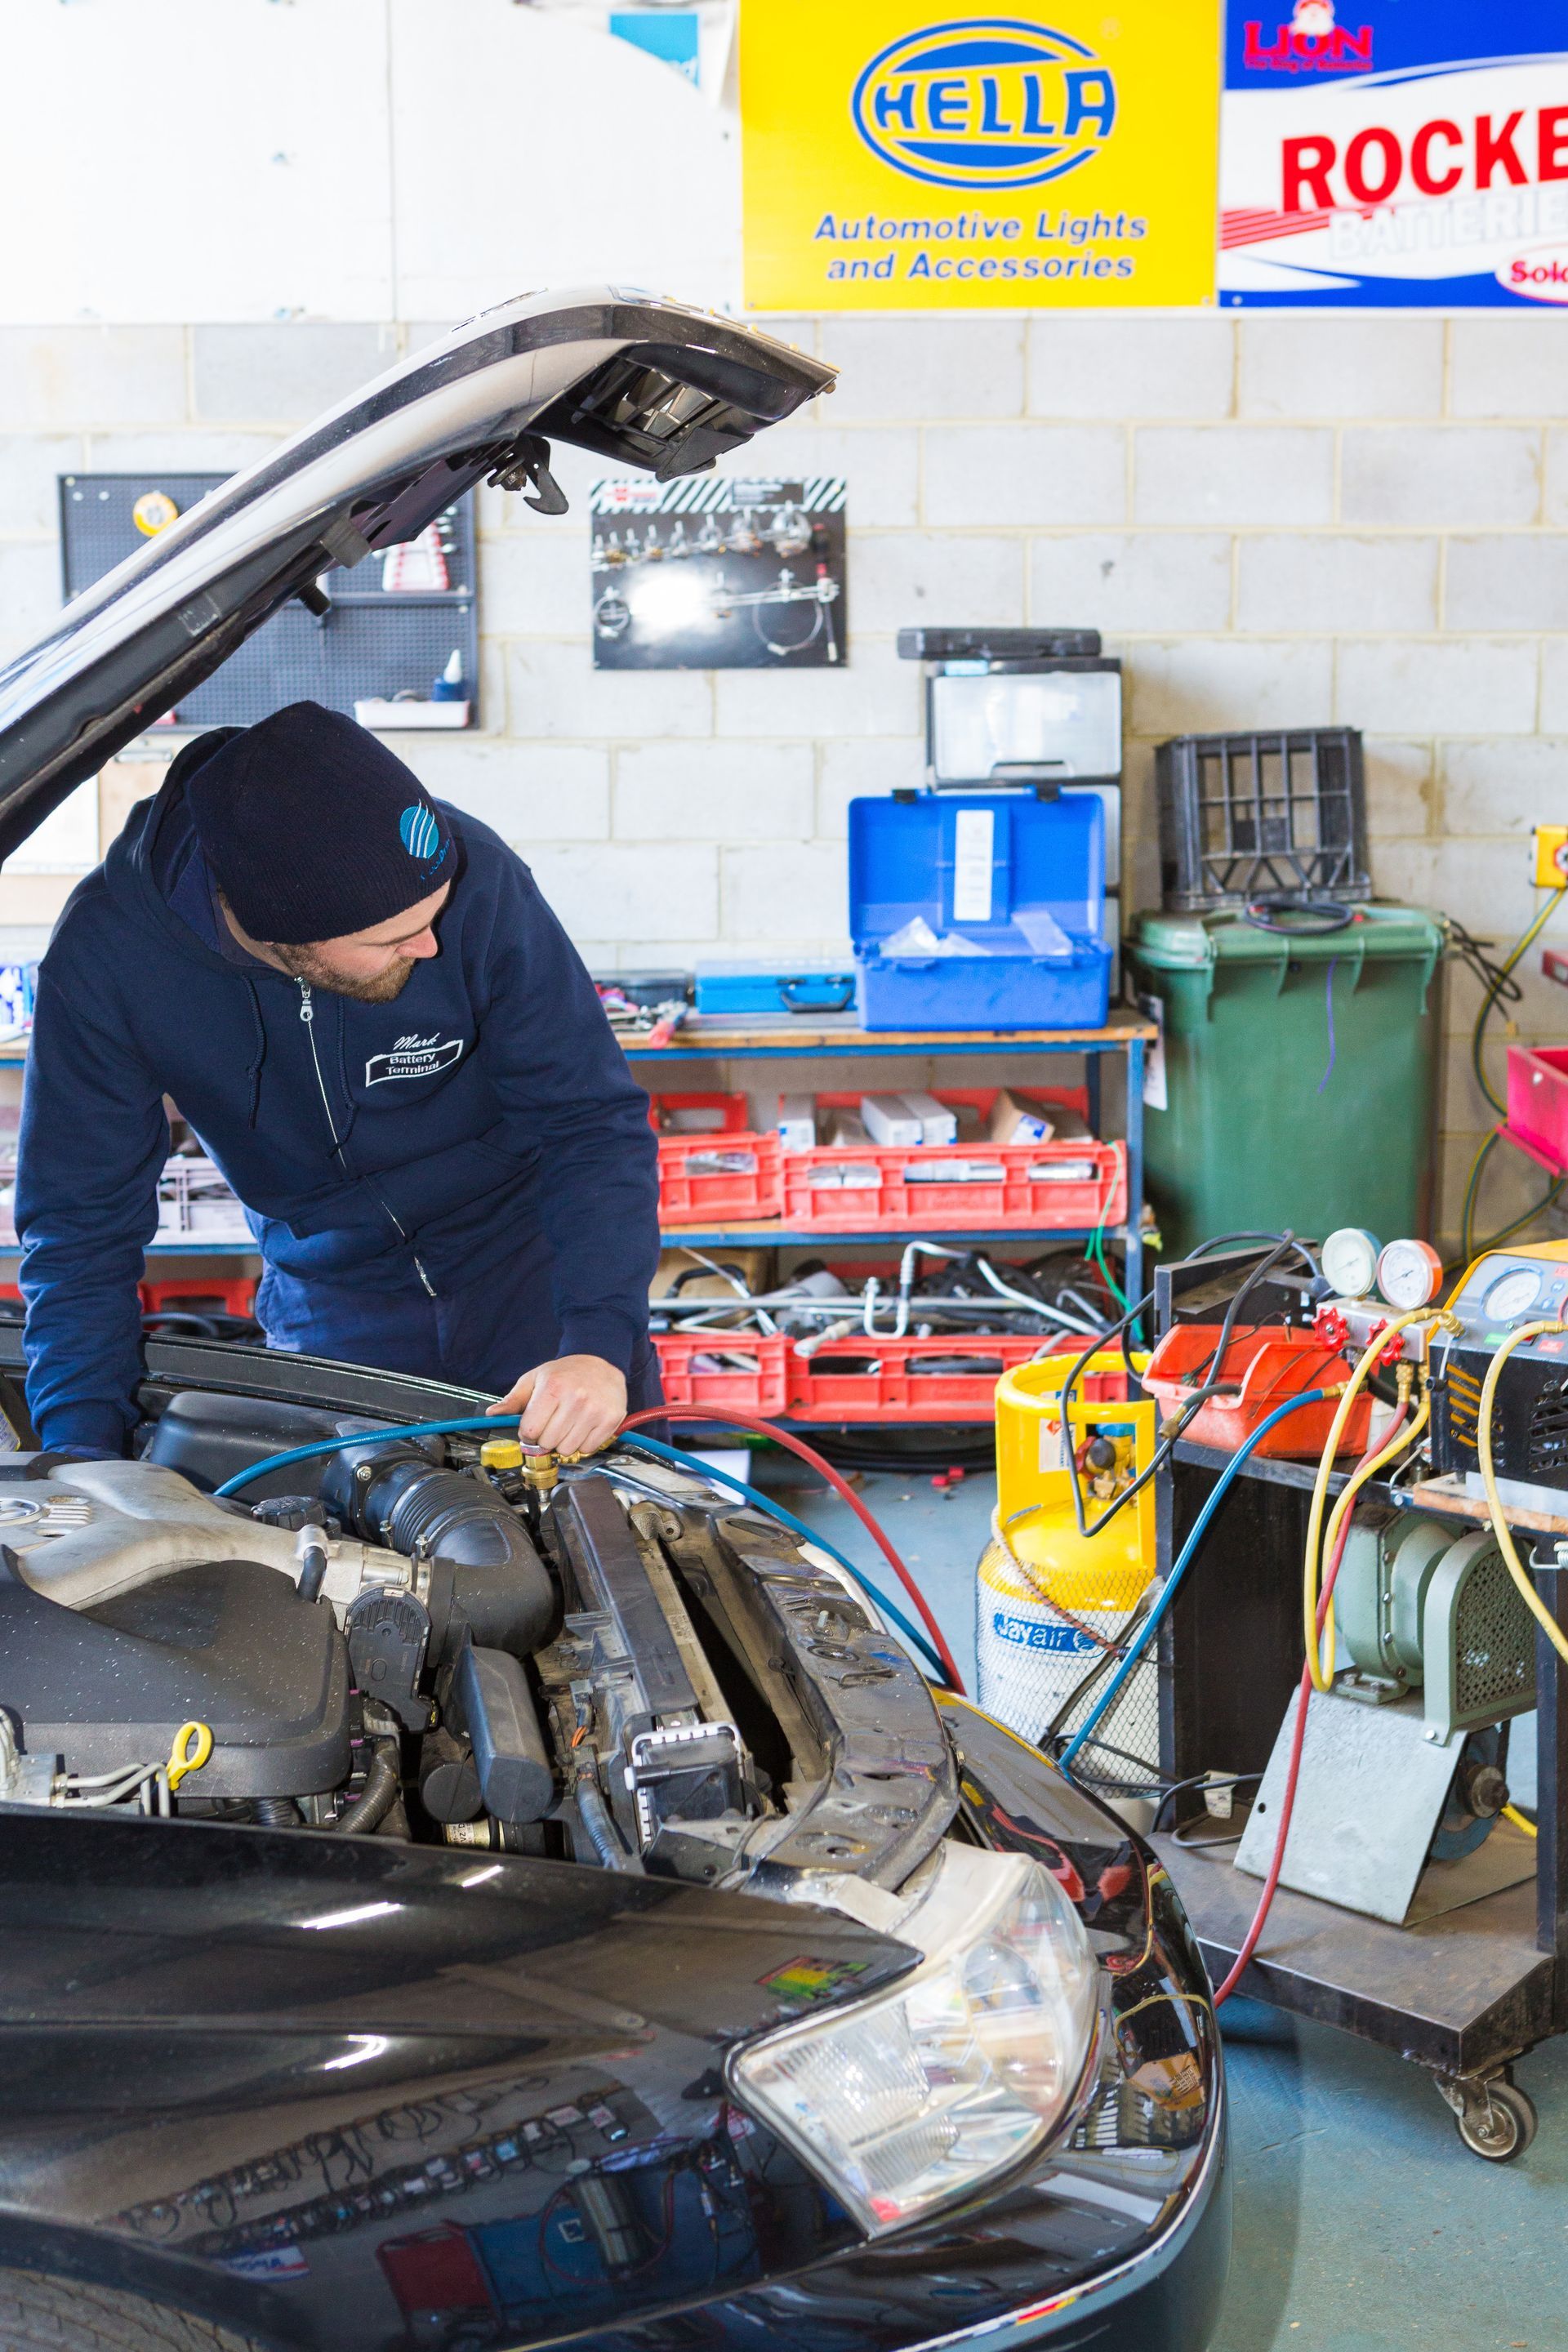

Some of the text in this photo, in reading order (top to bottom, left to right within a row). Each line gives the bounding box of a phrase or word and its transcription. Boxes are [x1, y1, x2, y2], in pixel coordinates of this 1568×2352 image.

[1245, 22, 1373, 59] LION
[874, 69, 1116, 137] HELLA
[1282, 105, 1568, 213] ROCKE
[814, 212, 1147, 244] Automotive Lights
[827, 251, 1134, 279] and Accessories
[393, 1032, 441, 1050] Mark
[385, 1061, 439, 1075] Terminal
[390, 1053, 436, 1064] Battery
